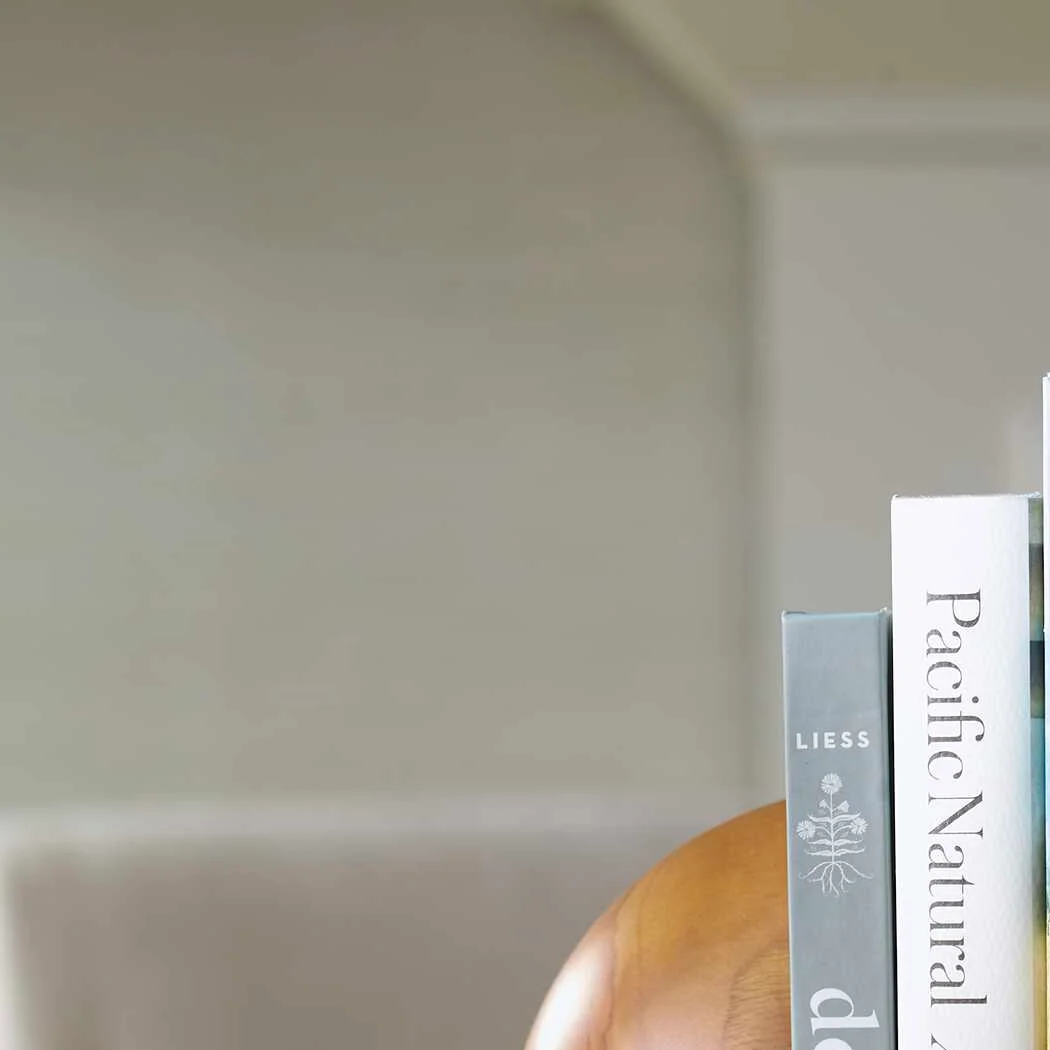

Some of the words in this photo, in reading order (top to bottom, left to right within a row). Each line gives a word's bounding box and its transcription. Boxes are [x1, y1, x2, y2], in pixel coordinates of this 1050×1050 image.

[796, 731, 871, 750] LIESS
[926, 588, 986, 781] Pacific
[927, 790, 988, 1008] Natural
